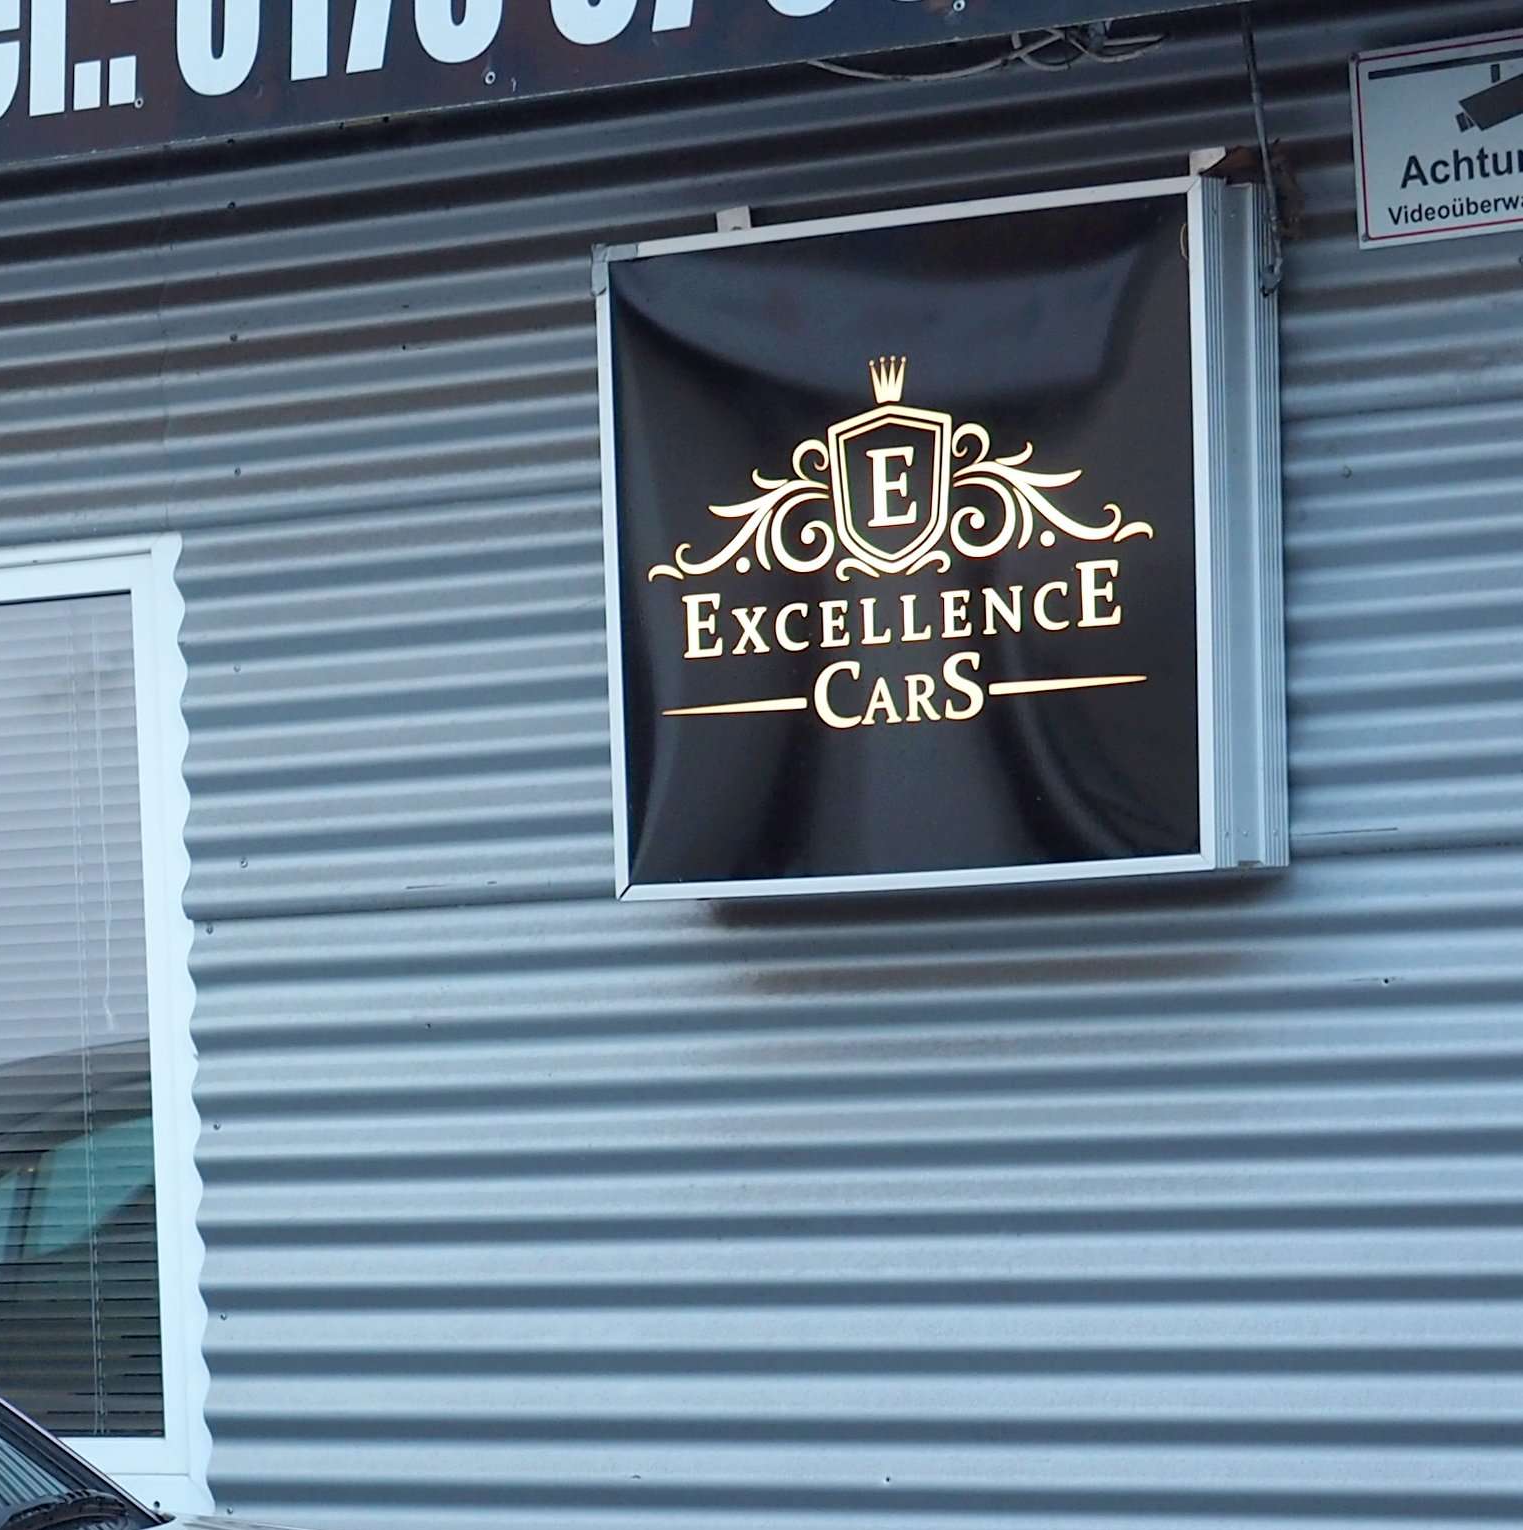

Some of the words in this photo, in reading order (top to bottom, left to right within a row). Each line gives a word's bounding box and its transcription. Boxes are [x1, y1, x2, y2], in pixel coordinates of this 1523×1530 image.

[1388, 194, 1523, 225] Videoüberw
[865, 444, 918, 529] E
[680, 558, 1123, 660] EXCELLENCE
[813, 650, 986, 729] CARS
